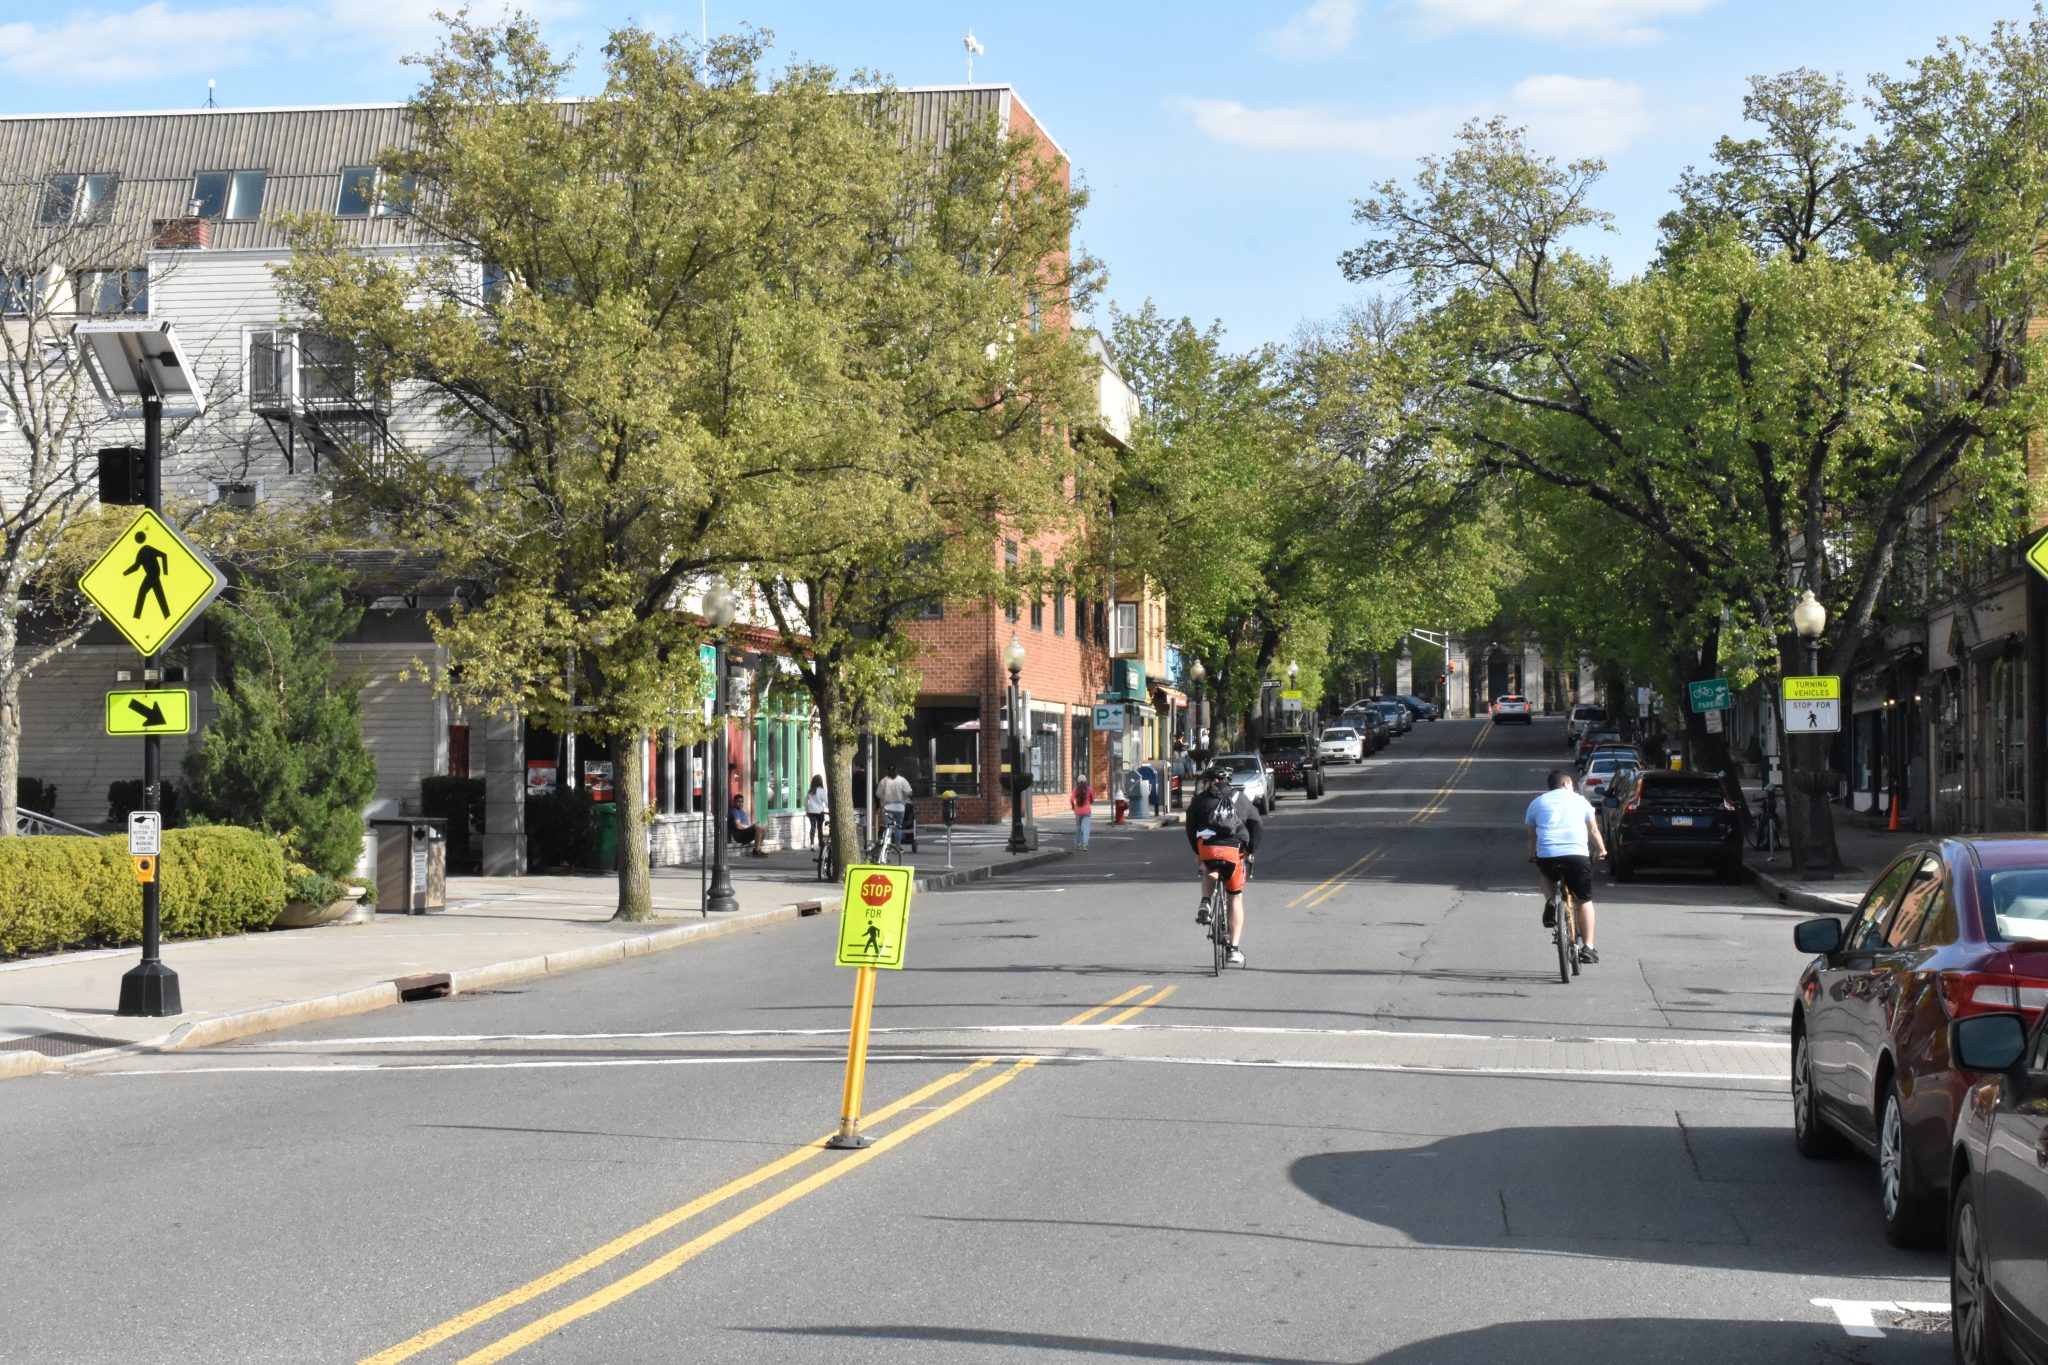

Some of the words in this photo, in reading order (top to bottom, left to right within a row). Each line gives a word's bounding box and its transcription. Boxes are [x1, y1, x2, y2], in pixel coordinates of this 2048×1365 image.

[1794, 689, 1830, 697] VEHICLES
[1698, 700, 1724, 709] PARKING
[1096, 709, 1109, 726] P
[862, 884, 892, 897] STOP
[865, 909, 882, 918] FOR
